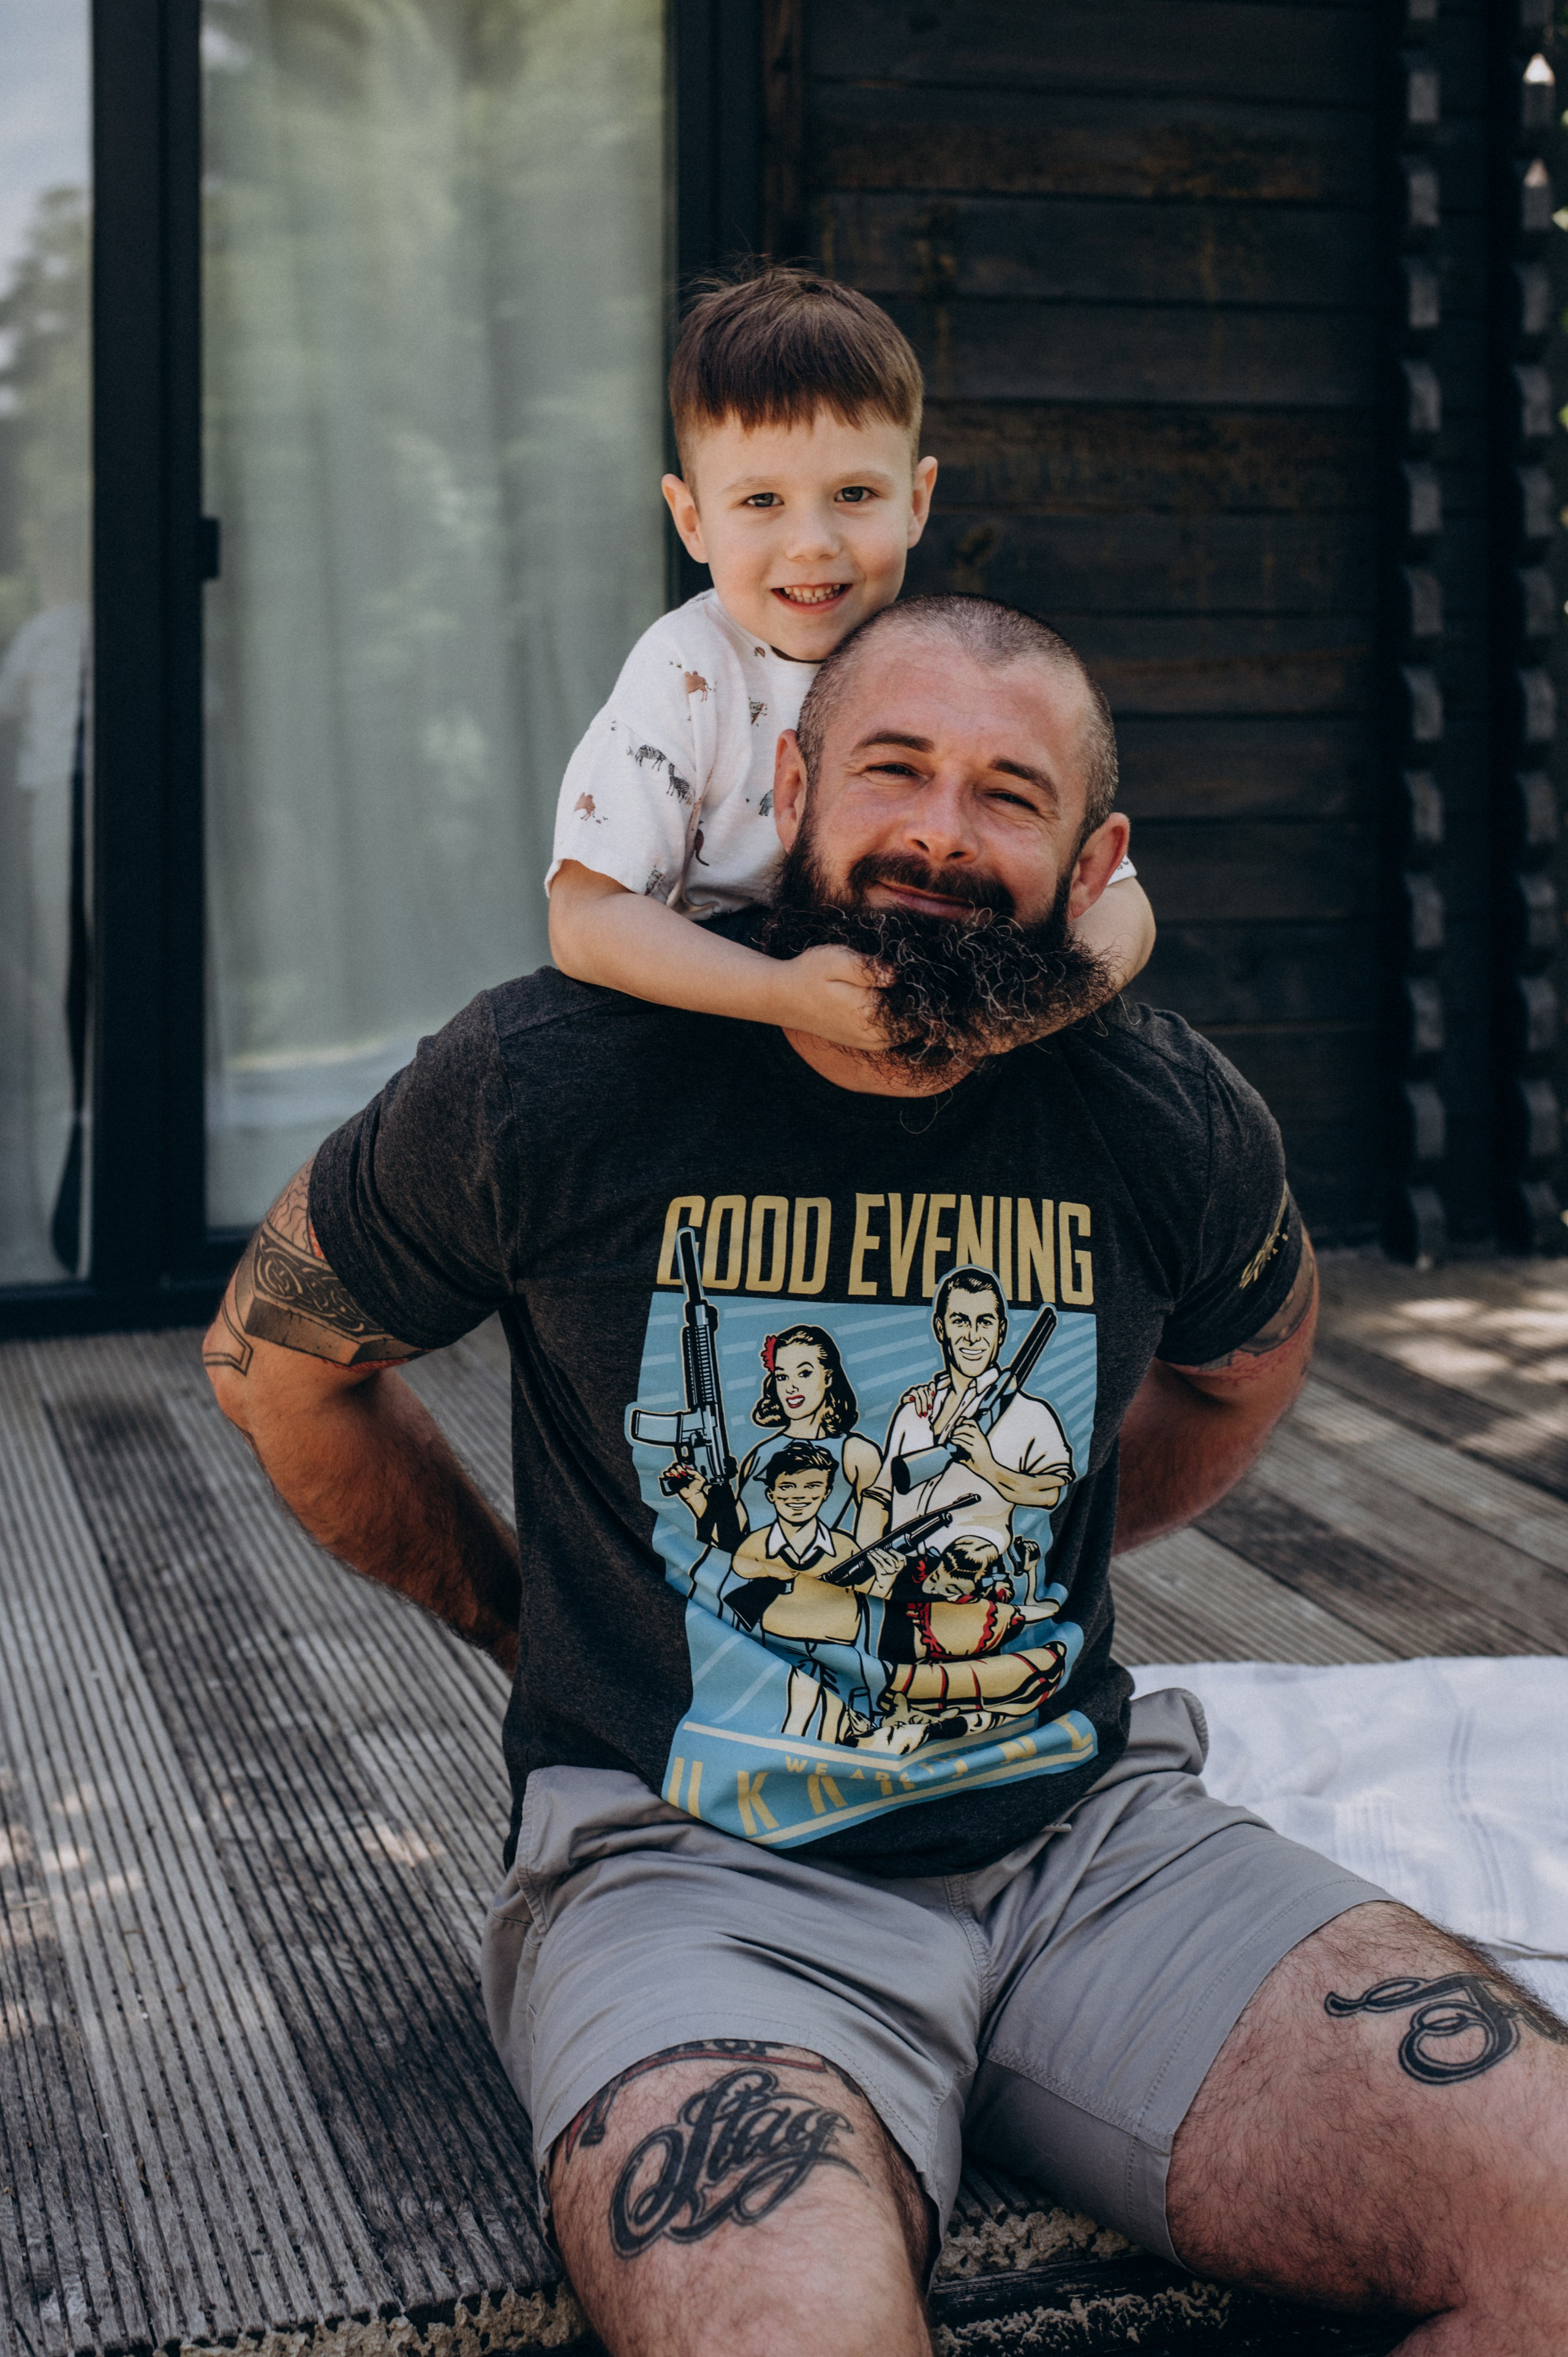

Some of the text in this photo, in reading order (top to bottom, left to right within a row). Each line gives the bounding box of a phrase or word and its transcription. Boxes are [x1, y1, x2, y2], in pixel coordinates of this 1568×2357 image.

[657, 1193, 1094, 1305] GOOD EVENING
[785, 1755, 829, 1776] WE
